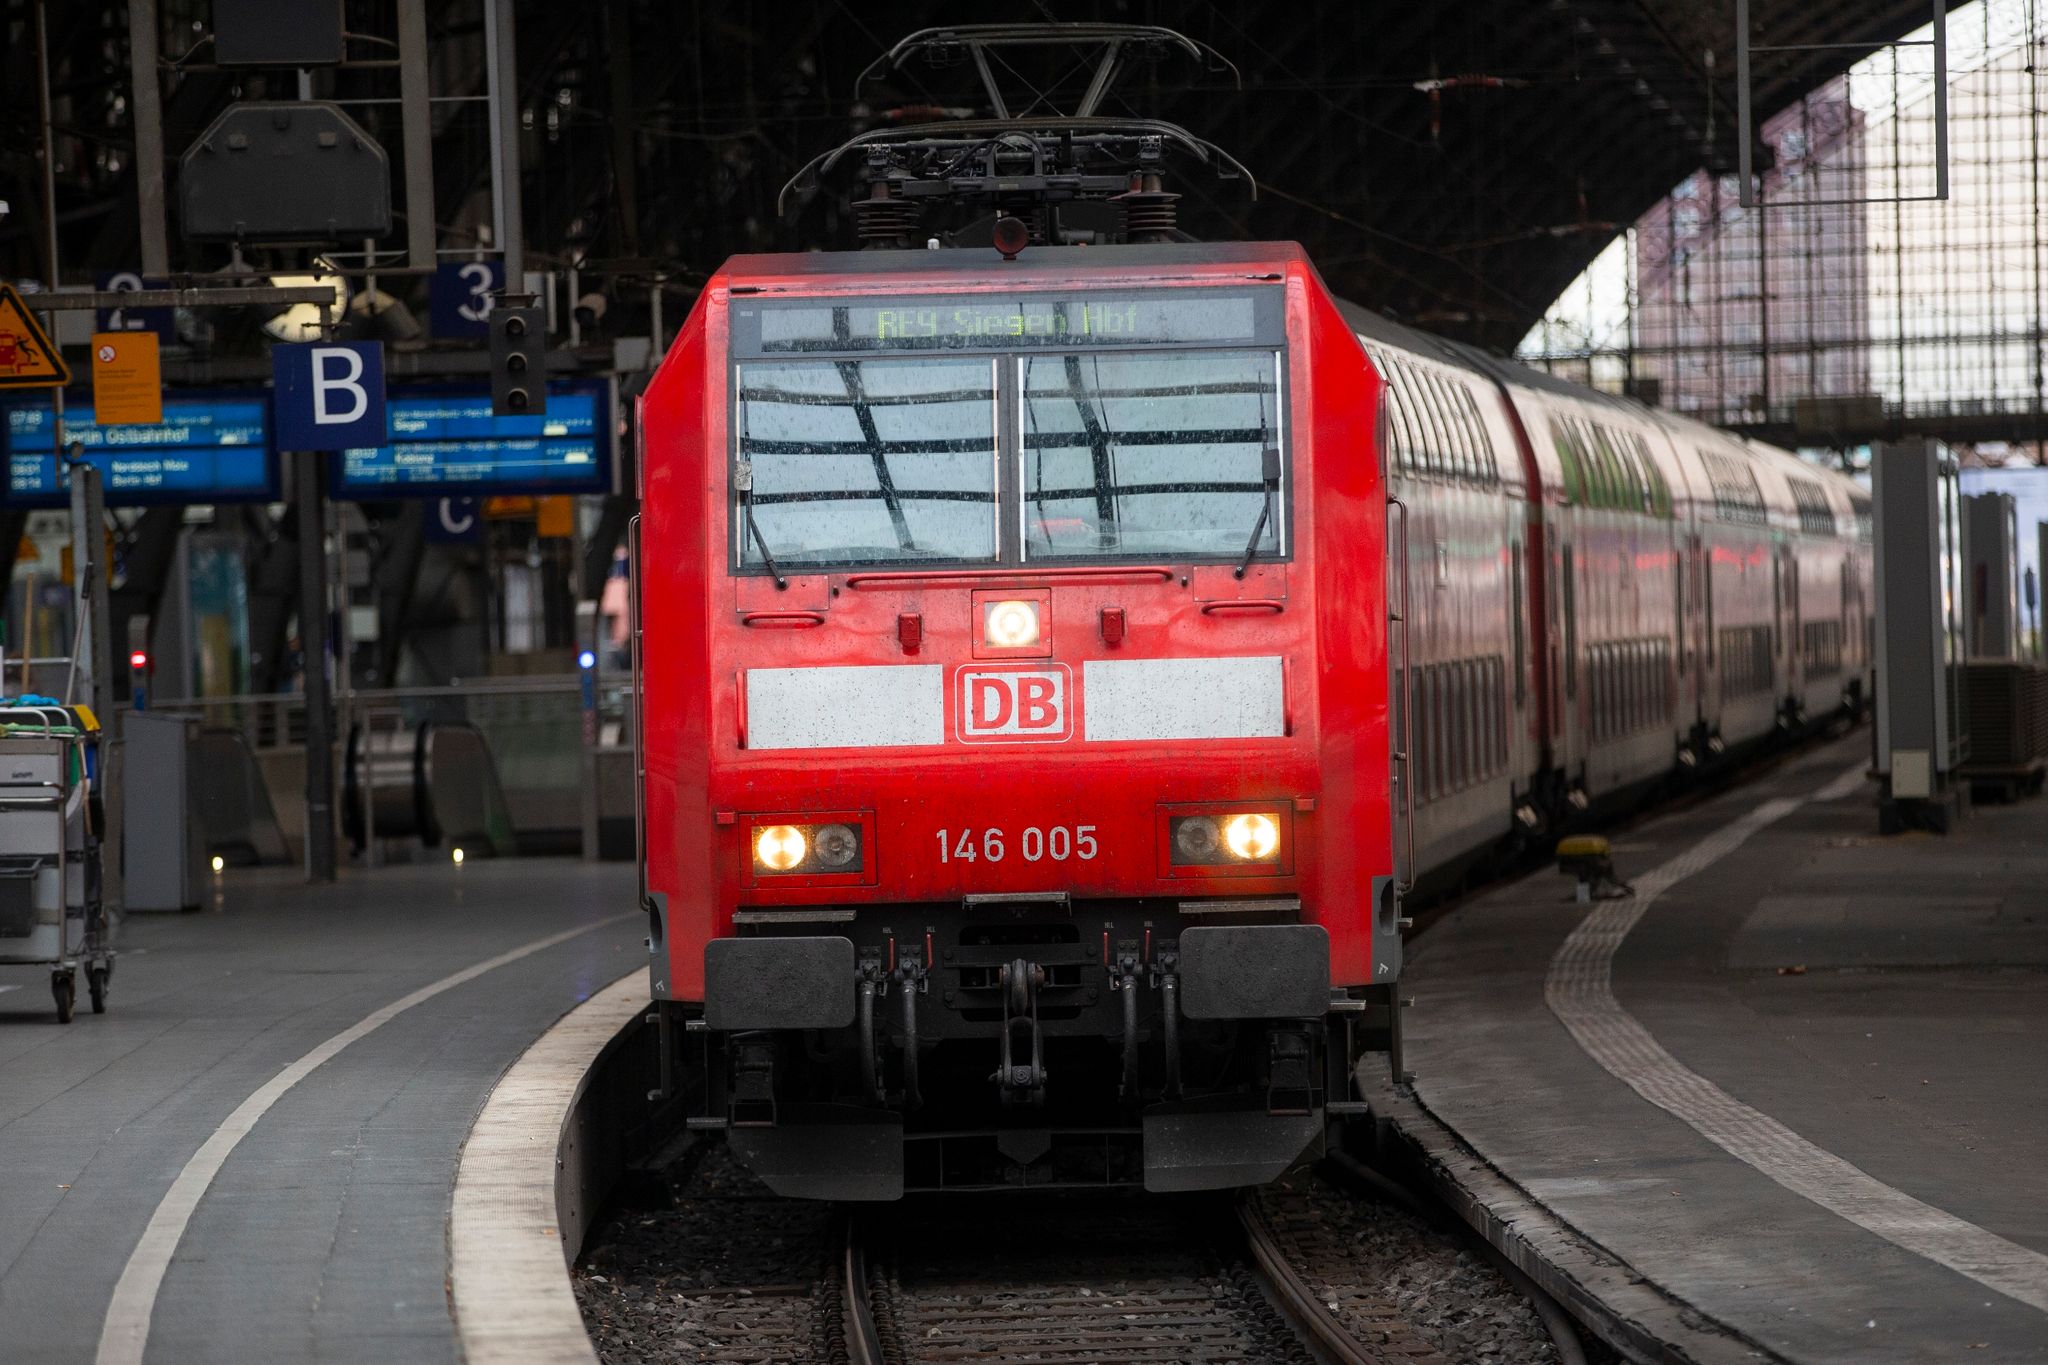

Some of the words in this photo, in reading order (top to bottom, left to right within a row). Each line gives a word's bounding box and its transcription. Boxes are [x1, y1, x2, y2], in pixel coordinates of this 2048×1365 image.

[457, 263, 496, 323] 3
[953, 308, 1067, 338] Siegen
[1082, 303, 1137, 336] Hbf
[311, 346, 368, 425] B
[106, 427, 189, 444] Ostbahnhof
[439, 497, 474, 534] C
[971, 677, 1058, 731] DB
[936, 827, 1004, 863] 146
[1022, 825, 1098, 861] 005
